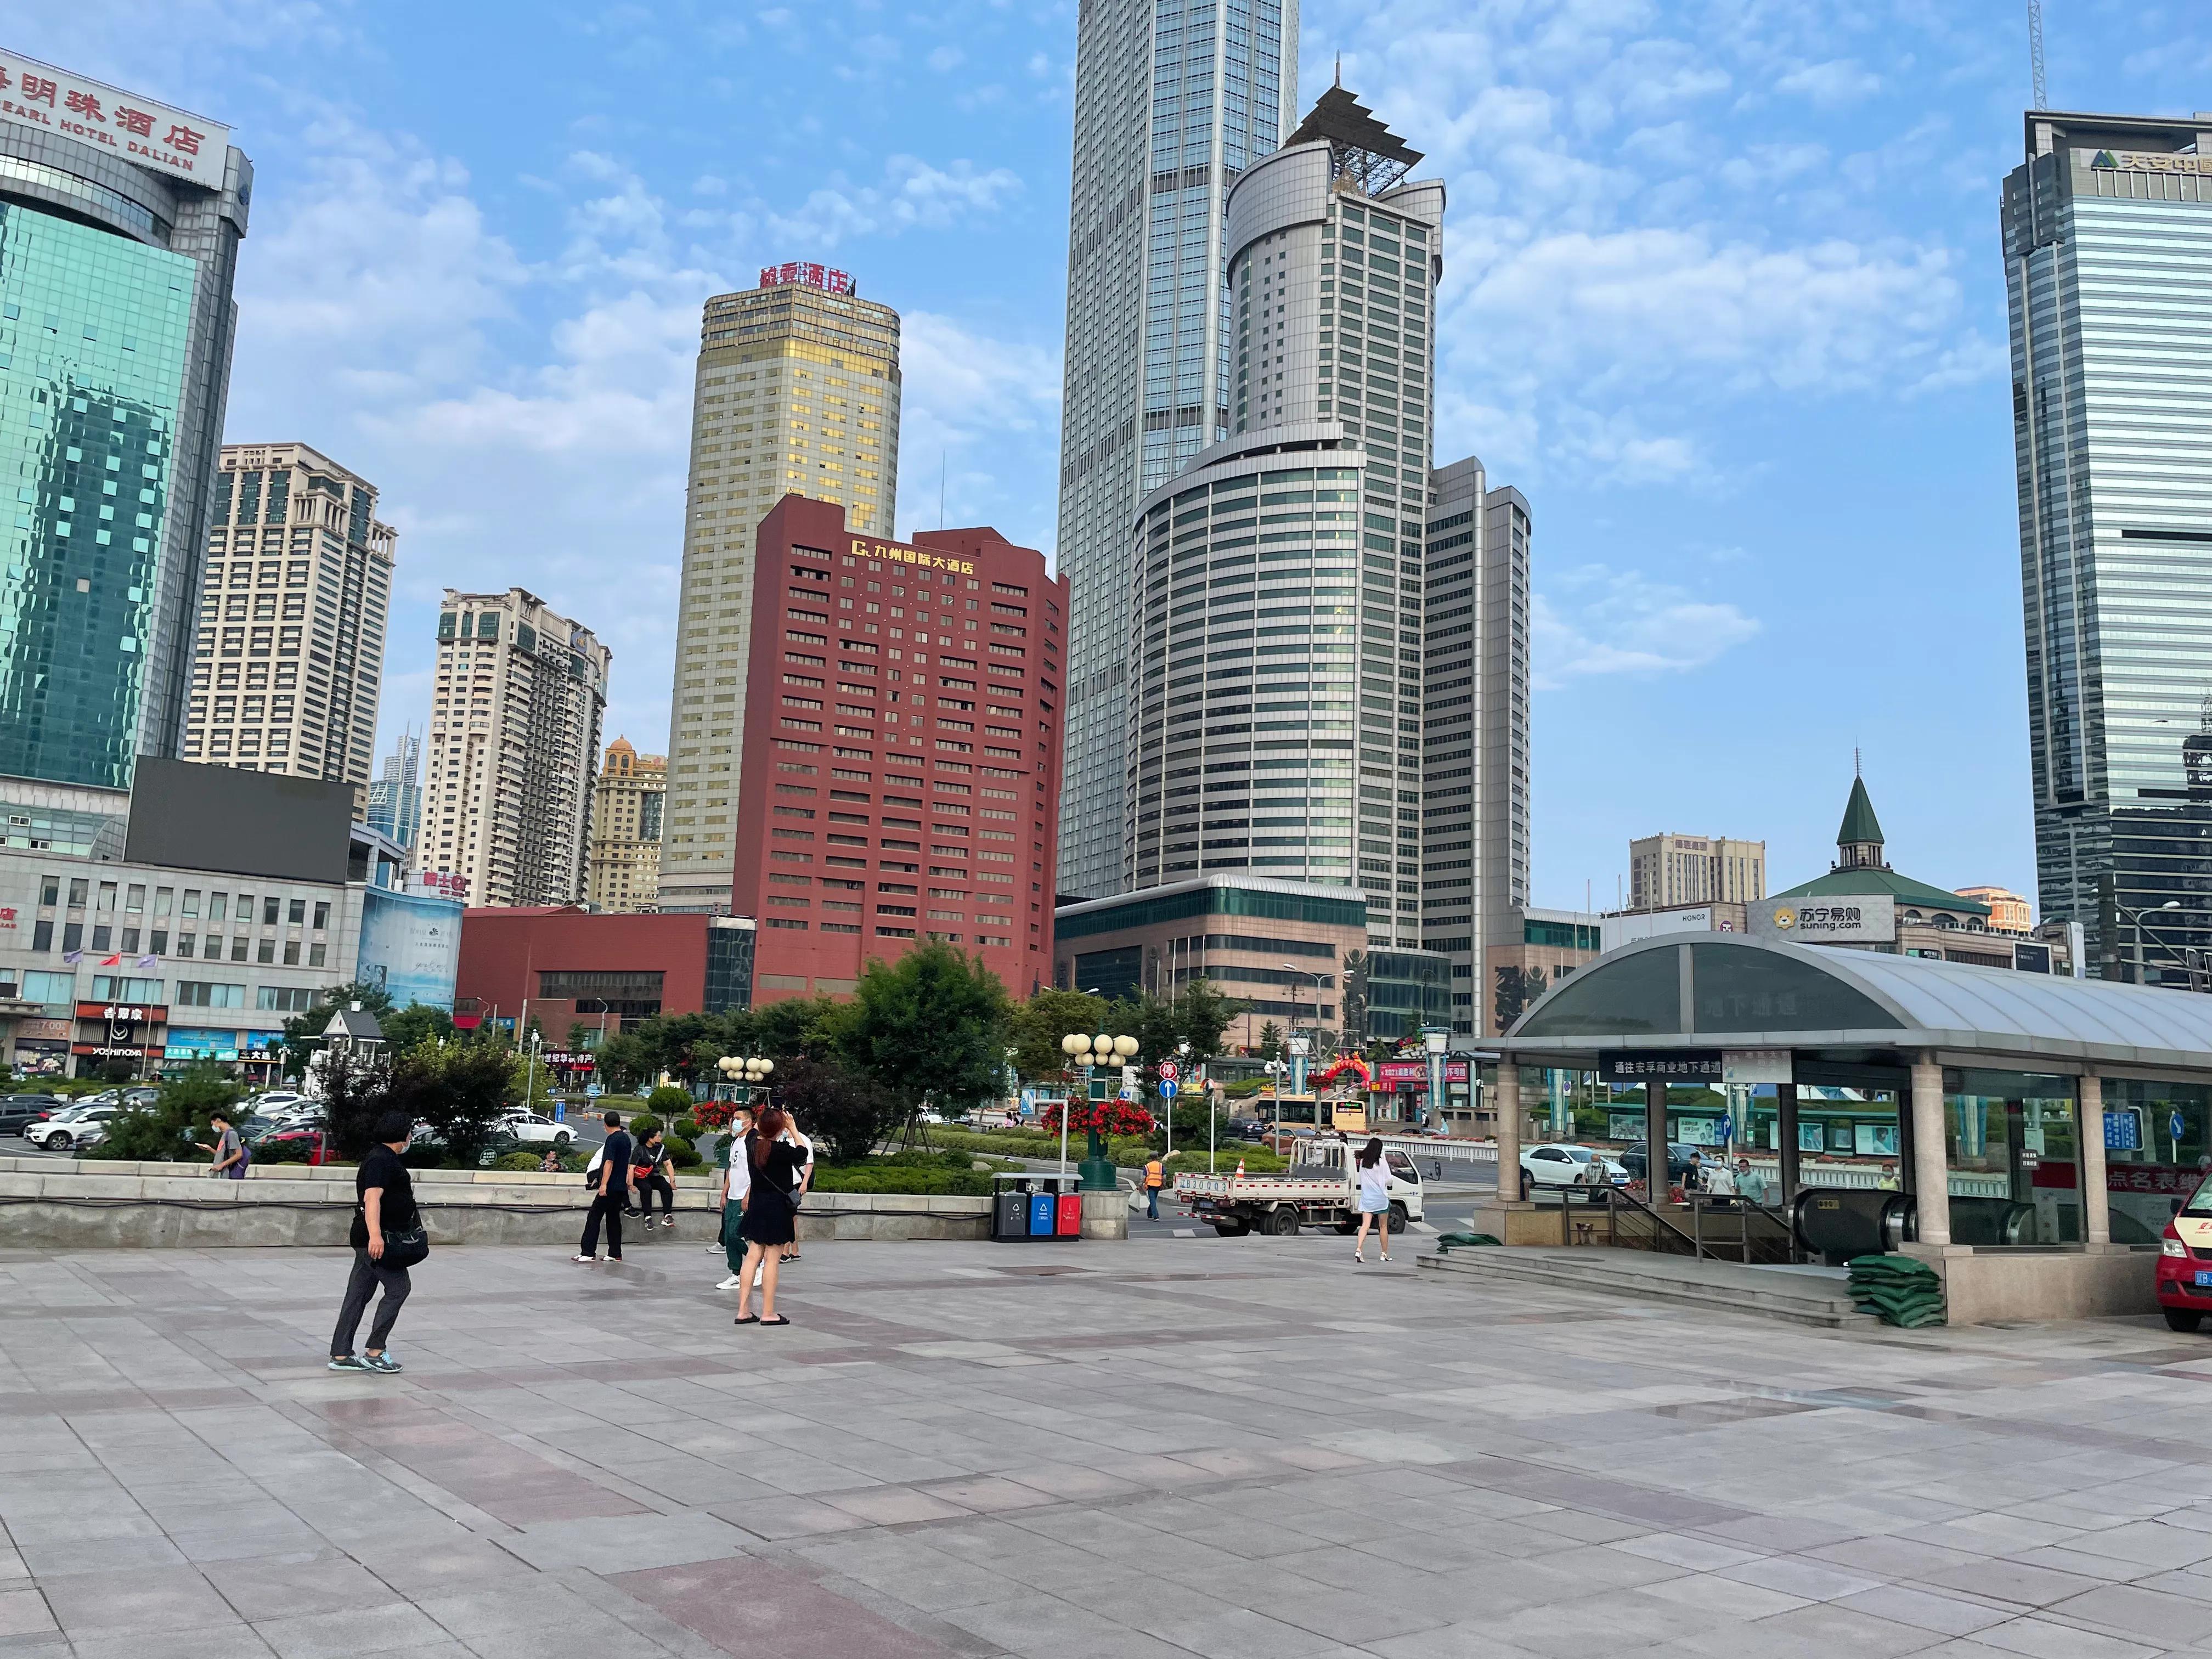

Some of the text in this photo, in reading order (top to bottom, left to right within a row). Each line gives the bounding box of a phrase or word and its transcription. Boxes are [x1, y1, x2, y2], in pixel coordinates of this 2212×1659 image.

[0, 99, 194, 171] EARL HOTEL DALIAN
[874, 544, 974, 575] 九州国际大酒店
[1683, 913, 1705, 922] HONOR
[1799, 907, 1861, 922] 苏宁易购
[1799, 922, 1861, 931] suning.com
[1162, 1064, 1174, 1077] 停
[733, 1150, 739, 1163] 5
